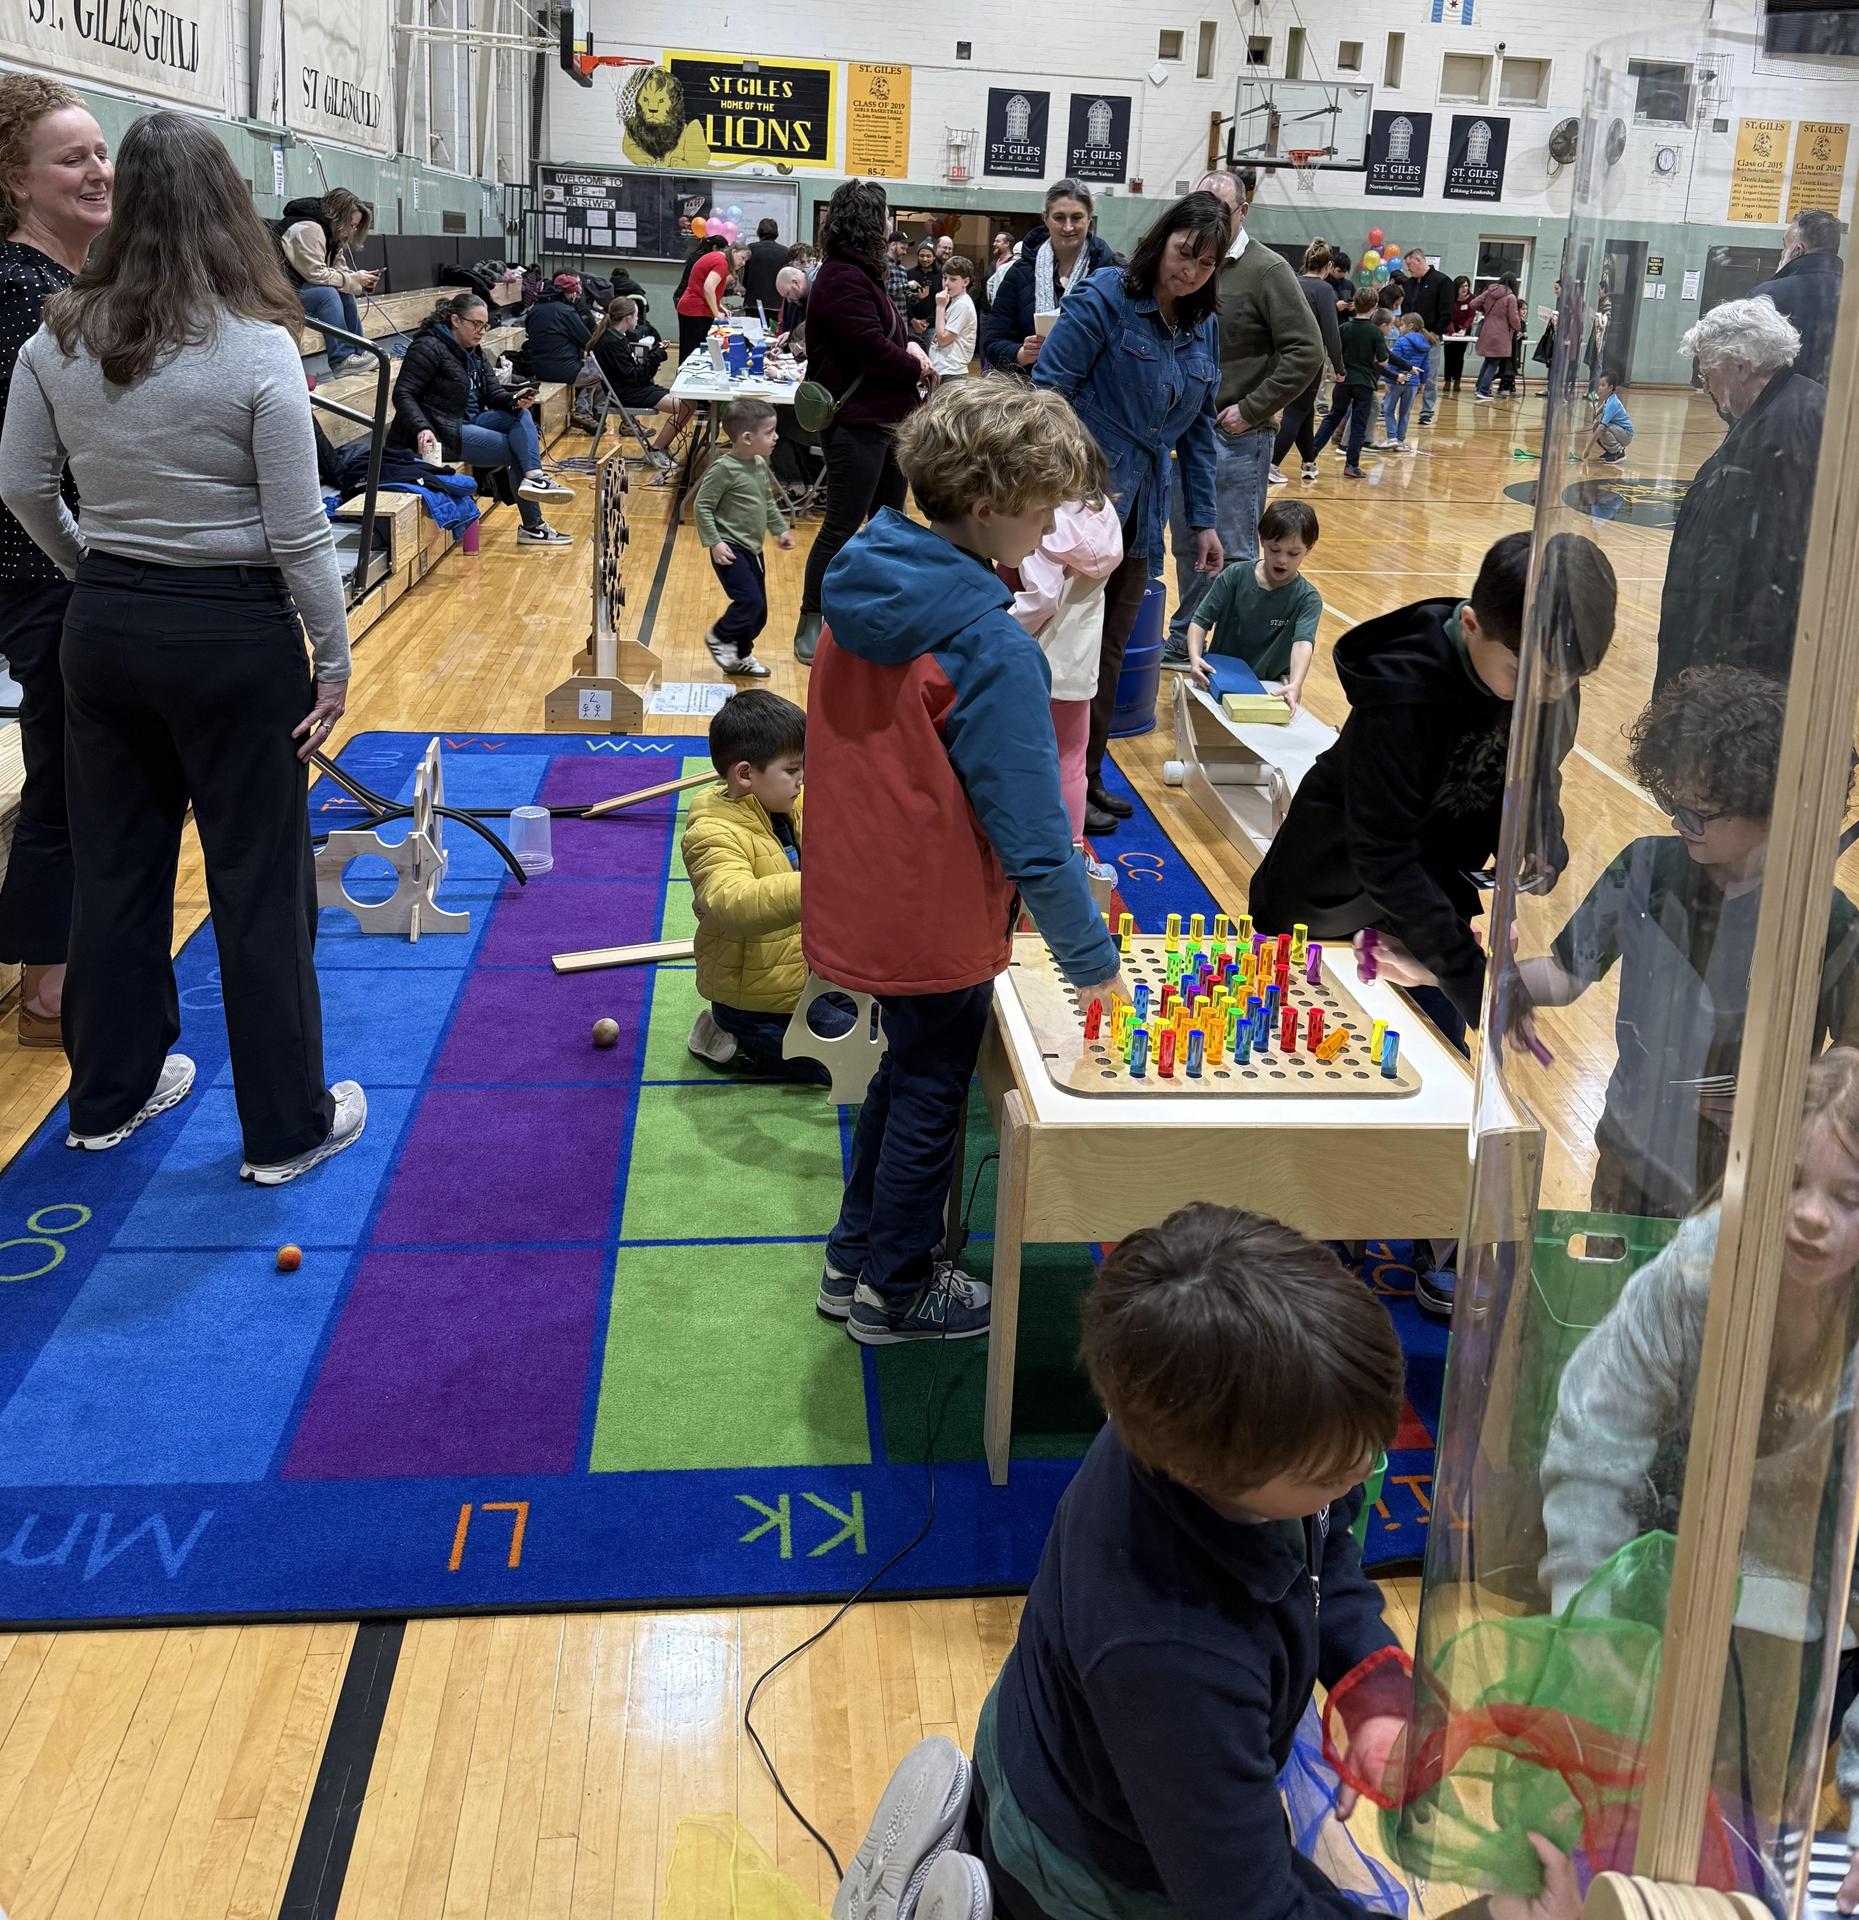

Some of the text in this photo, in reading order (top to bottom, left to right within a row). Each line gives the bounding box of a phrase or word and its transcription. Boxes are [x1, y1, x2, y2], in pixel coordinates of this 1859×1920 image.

[143, 5, 199, 73] GUILD
[858, 64, 902, 75] ST. GILES
[708, 76, 793, 98] ST. GILES
[302, 66, 319, 110] ST
[324, 74, 354, 120] GILES
[720, 100, 775, 112] HOME OF THE
[852, 100, 877, 108] CLASS
[890, 102, 906, 110] 2019
[1744, 120, 1785, 131] ST. GILES
[1803, 124, 1844, 135] ST. GILES
[706, 114, 812, 152] LIONS
[991, 143, 1041, 156] ST. GILES
[1073, 149, 1122, 160] ST. GILES
[991, 154, 1039, 162] SCHOOL
[1073, 159, 1120, 167] SCHOOL
[1373, 163, 1421, 175] ST. GILES
[1767, 161, 1783, 169] 2015
[1795, 162, 1843, 172] Class of 2017
[867, 167, 886, 176] 85-2
[1373, 173, 1419, 181] SCHOOL
[1451, 168, 1499, 179] ST. GILES
[557, 174, 623, 187] WELCOME TO
[1451, 177, 1497, 185] SCHOOL
[581, 198, 615, 209] SIWEK
[590, 692, 598, 703] 2
[917, 1290, 953, 1323] N
